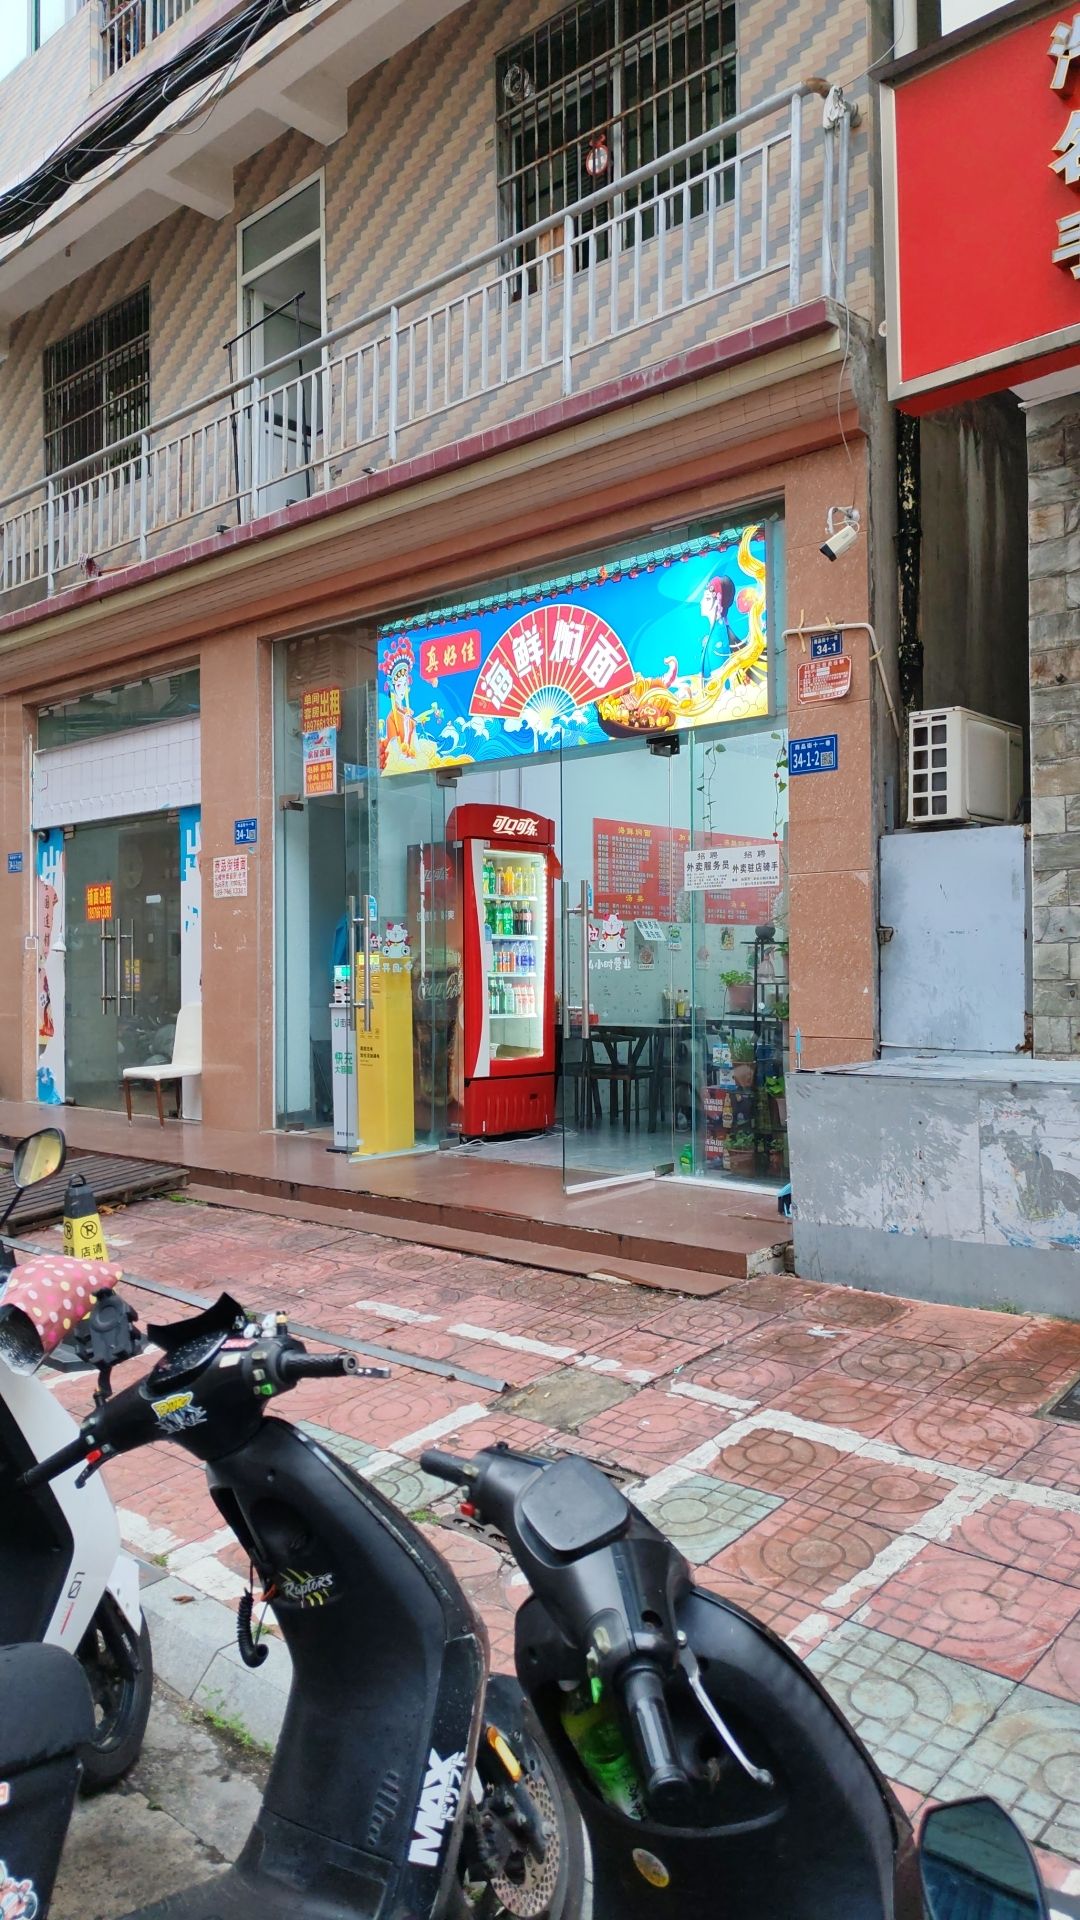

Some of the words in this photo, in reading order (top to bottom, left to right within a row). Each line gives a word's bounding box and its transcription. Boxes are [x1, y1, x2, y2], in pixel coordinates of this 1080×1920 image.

[425, 637, 476, 673] 真好佳
[816, 642, 836, 655] 34-1
[792, 750, 820, 769] 34-1-2
[492, 815, 540, 837] 可口可乐
[697, 851, 718, 860] 招聘
[744, 849, 766, 859] 招聘
[686, 860, 730, 872] 外卖服务员
[588, 957, 631, 971] 4小时营业
[408, 1747, 460, 1867] MAX
